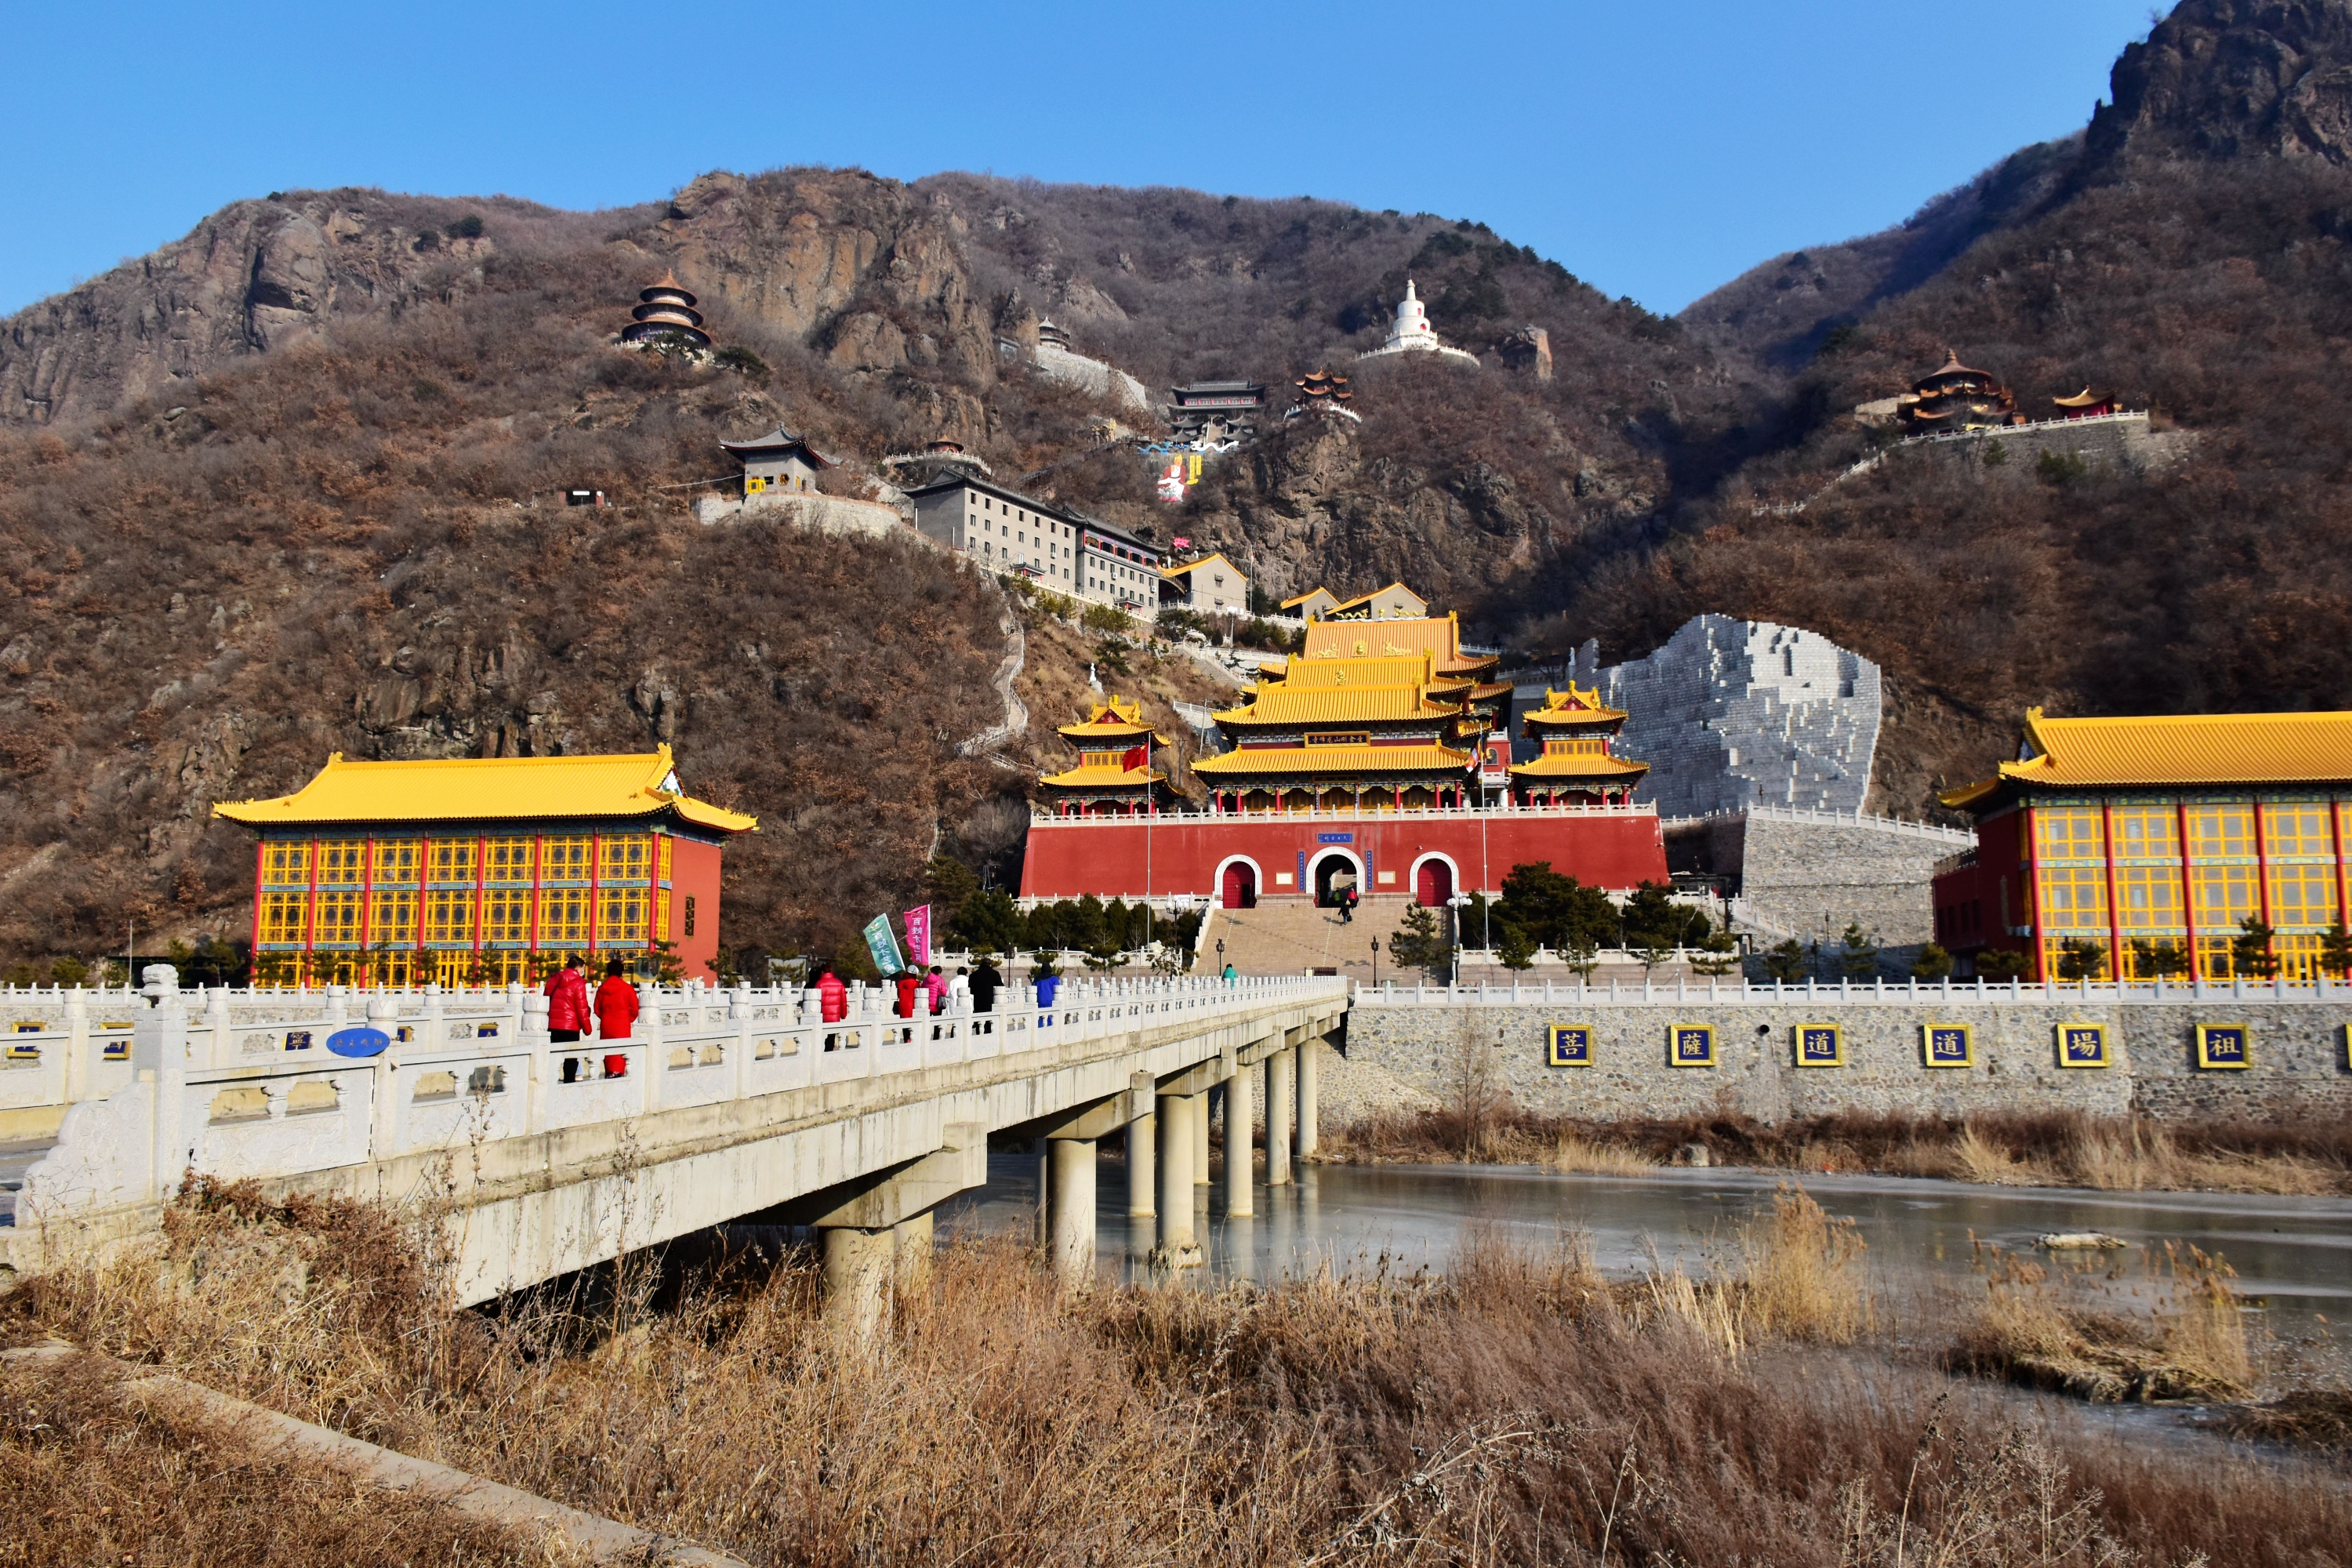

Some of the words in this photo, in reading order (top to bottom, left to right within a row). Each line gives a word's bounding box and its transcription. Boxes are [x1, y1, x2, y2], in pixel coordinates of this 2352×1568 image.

[1559, 1033, 1584, 1056] 菩
[1682, 1033, 1704, 1056] 薩
[1806, 1033, 1834, 1055] 道
[1935, 1033, 1963, 1056] 道
[2070, 1032, 2098, 1058] 場
[2209, 1033, 2241, 1057] 祖
